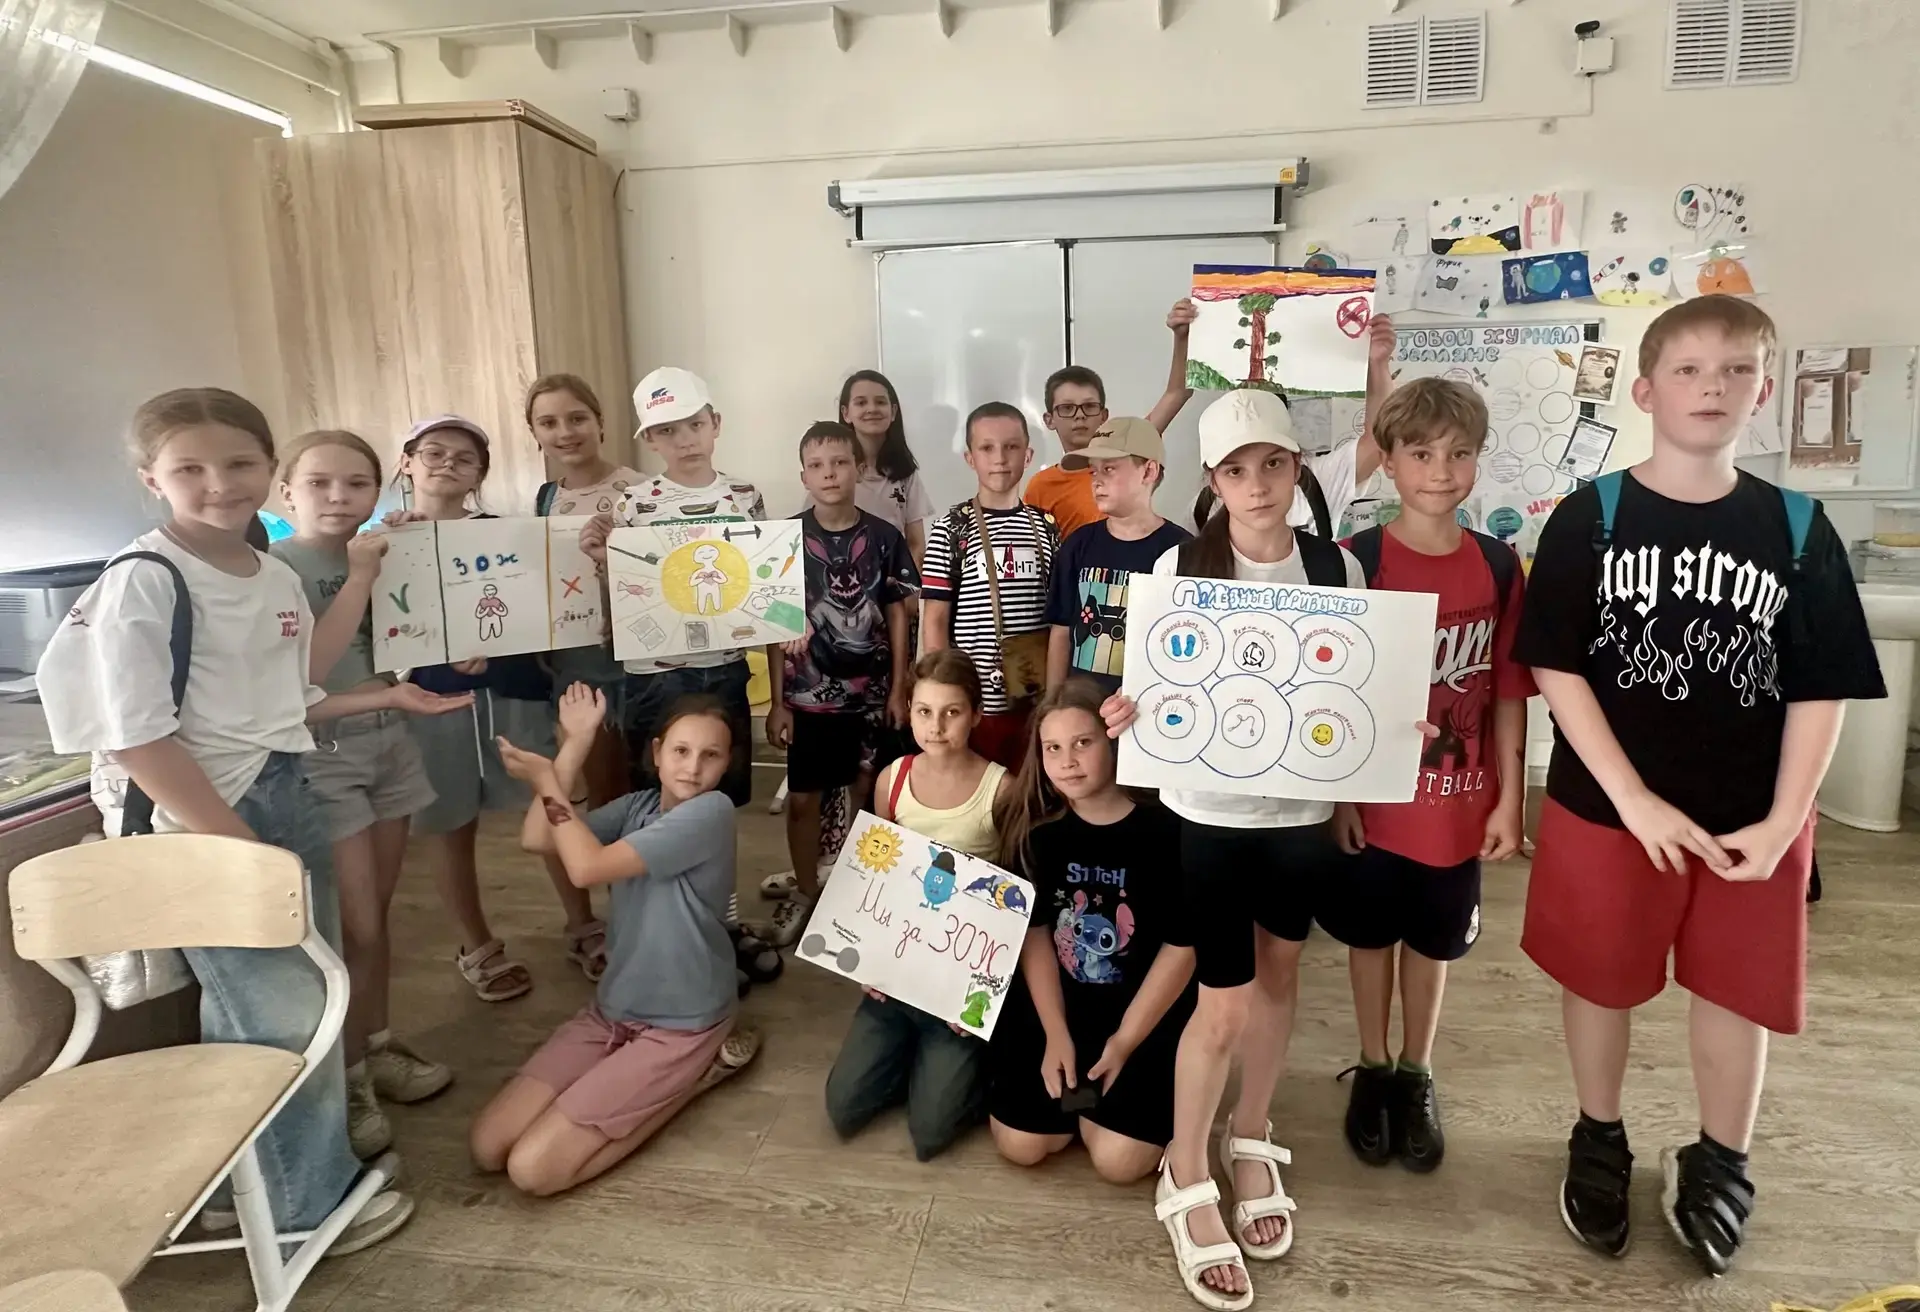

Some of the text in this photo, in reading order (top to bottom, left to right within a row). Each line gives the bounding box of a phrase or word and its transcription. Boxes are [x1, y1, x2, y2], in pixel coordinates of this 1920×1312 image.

[1397, 326, 1580, 347] ТОВОЙ ЖУРНАЛ
[1079, 566, 1109, 583] START
[1276, 590, 1366, 615] ПРИВЫЧКИ
[1416, 771, 1483, 796] TBALL
[1066, 862, 1126, 888] STTCH
[927, 914, 1009, 979] ЗОЖ
